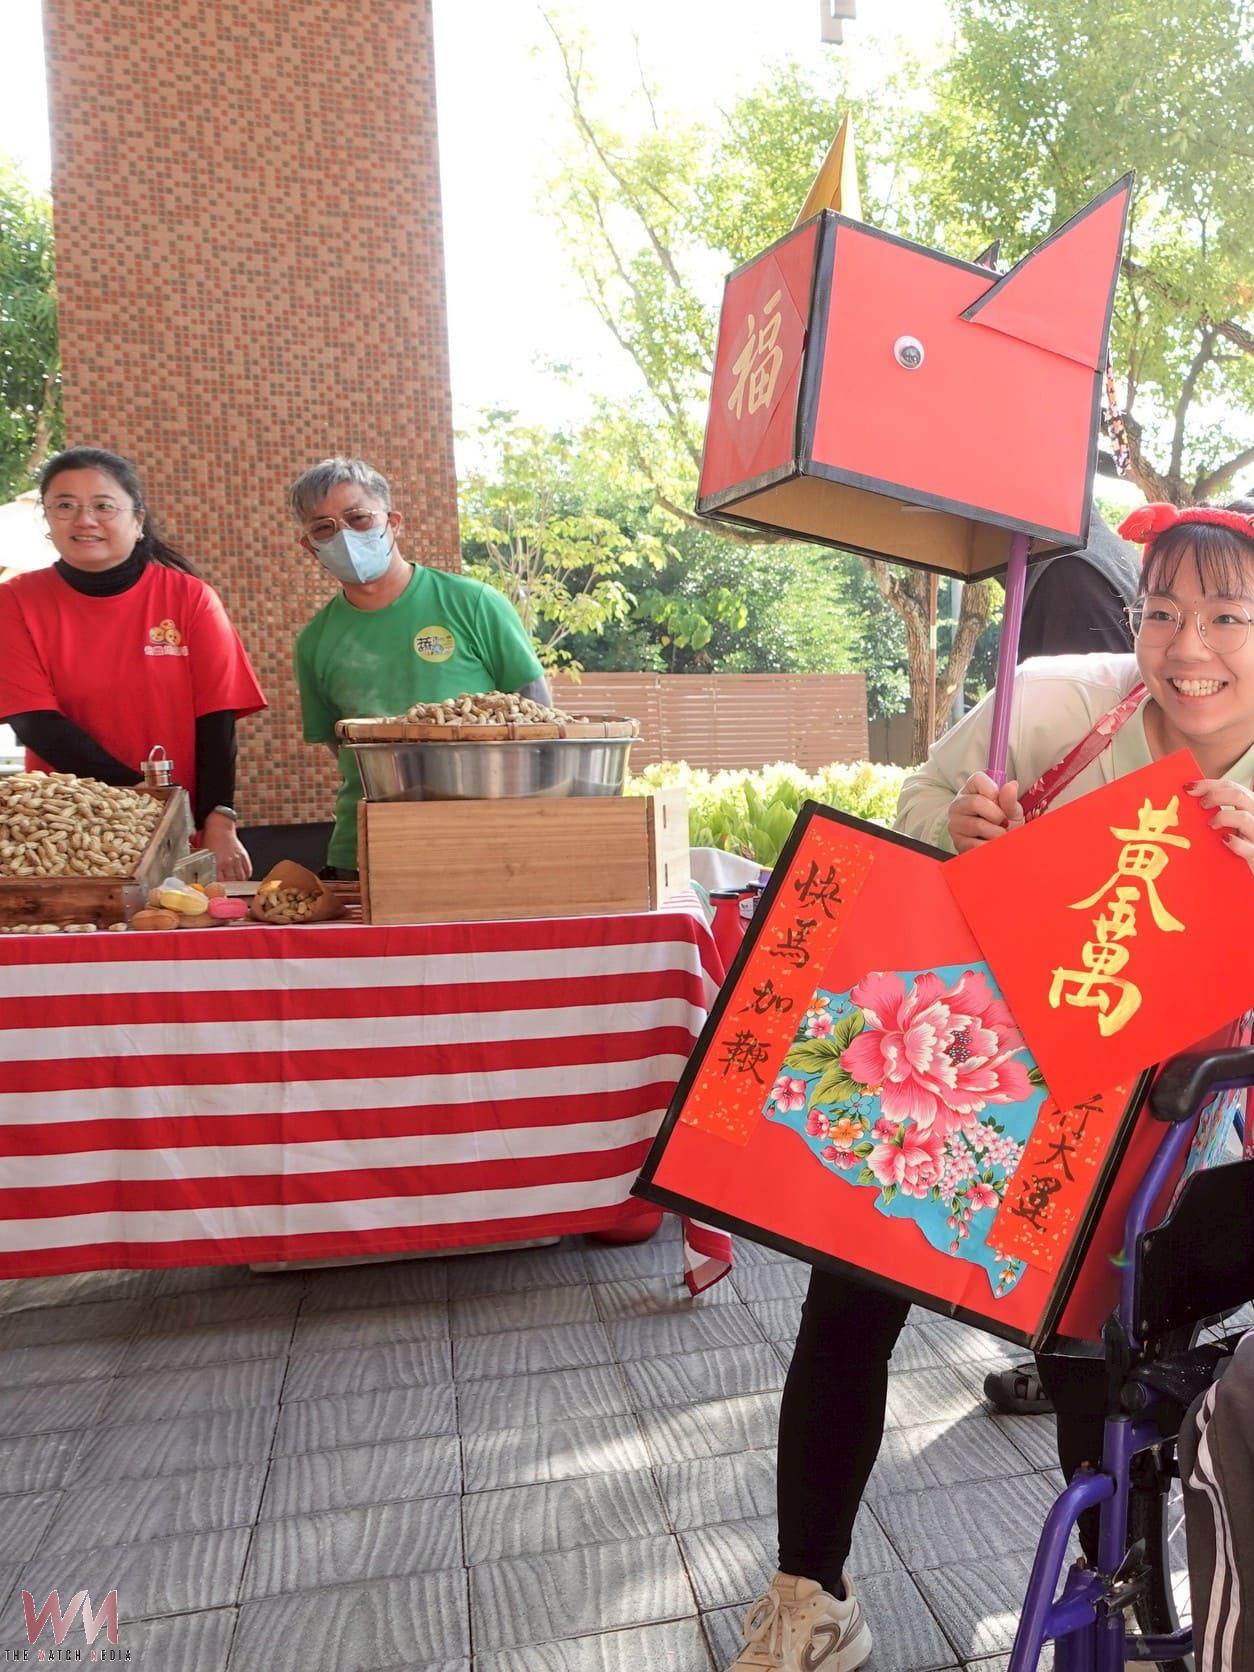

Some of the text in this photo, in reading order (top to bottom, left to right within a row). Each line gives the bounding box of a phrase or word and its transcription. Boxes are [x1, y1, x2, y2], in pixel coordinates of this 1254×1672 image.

[728, 289, 783, 421] 福
[717, 860, 842, 1084] 快馬加鞭
